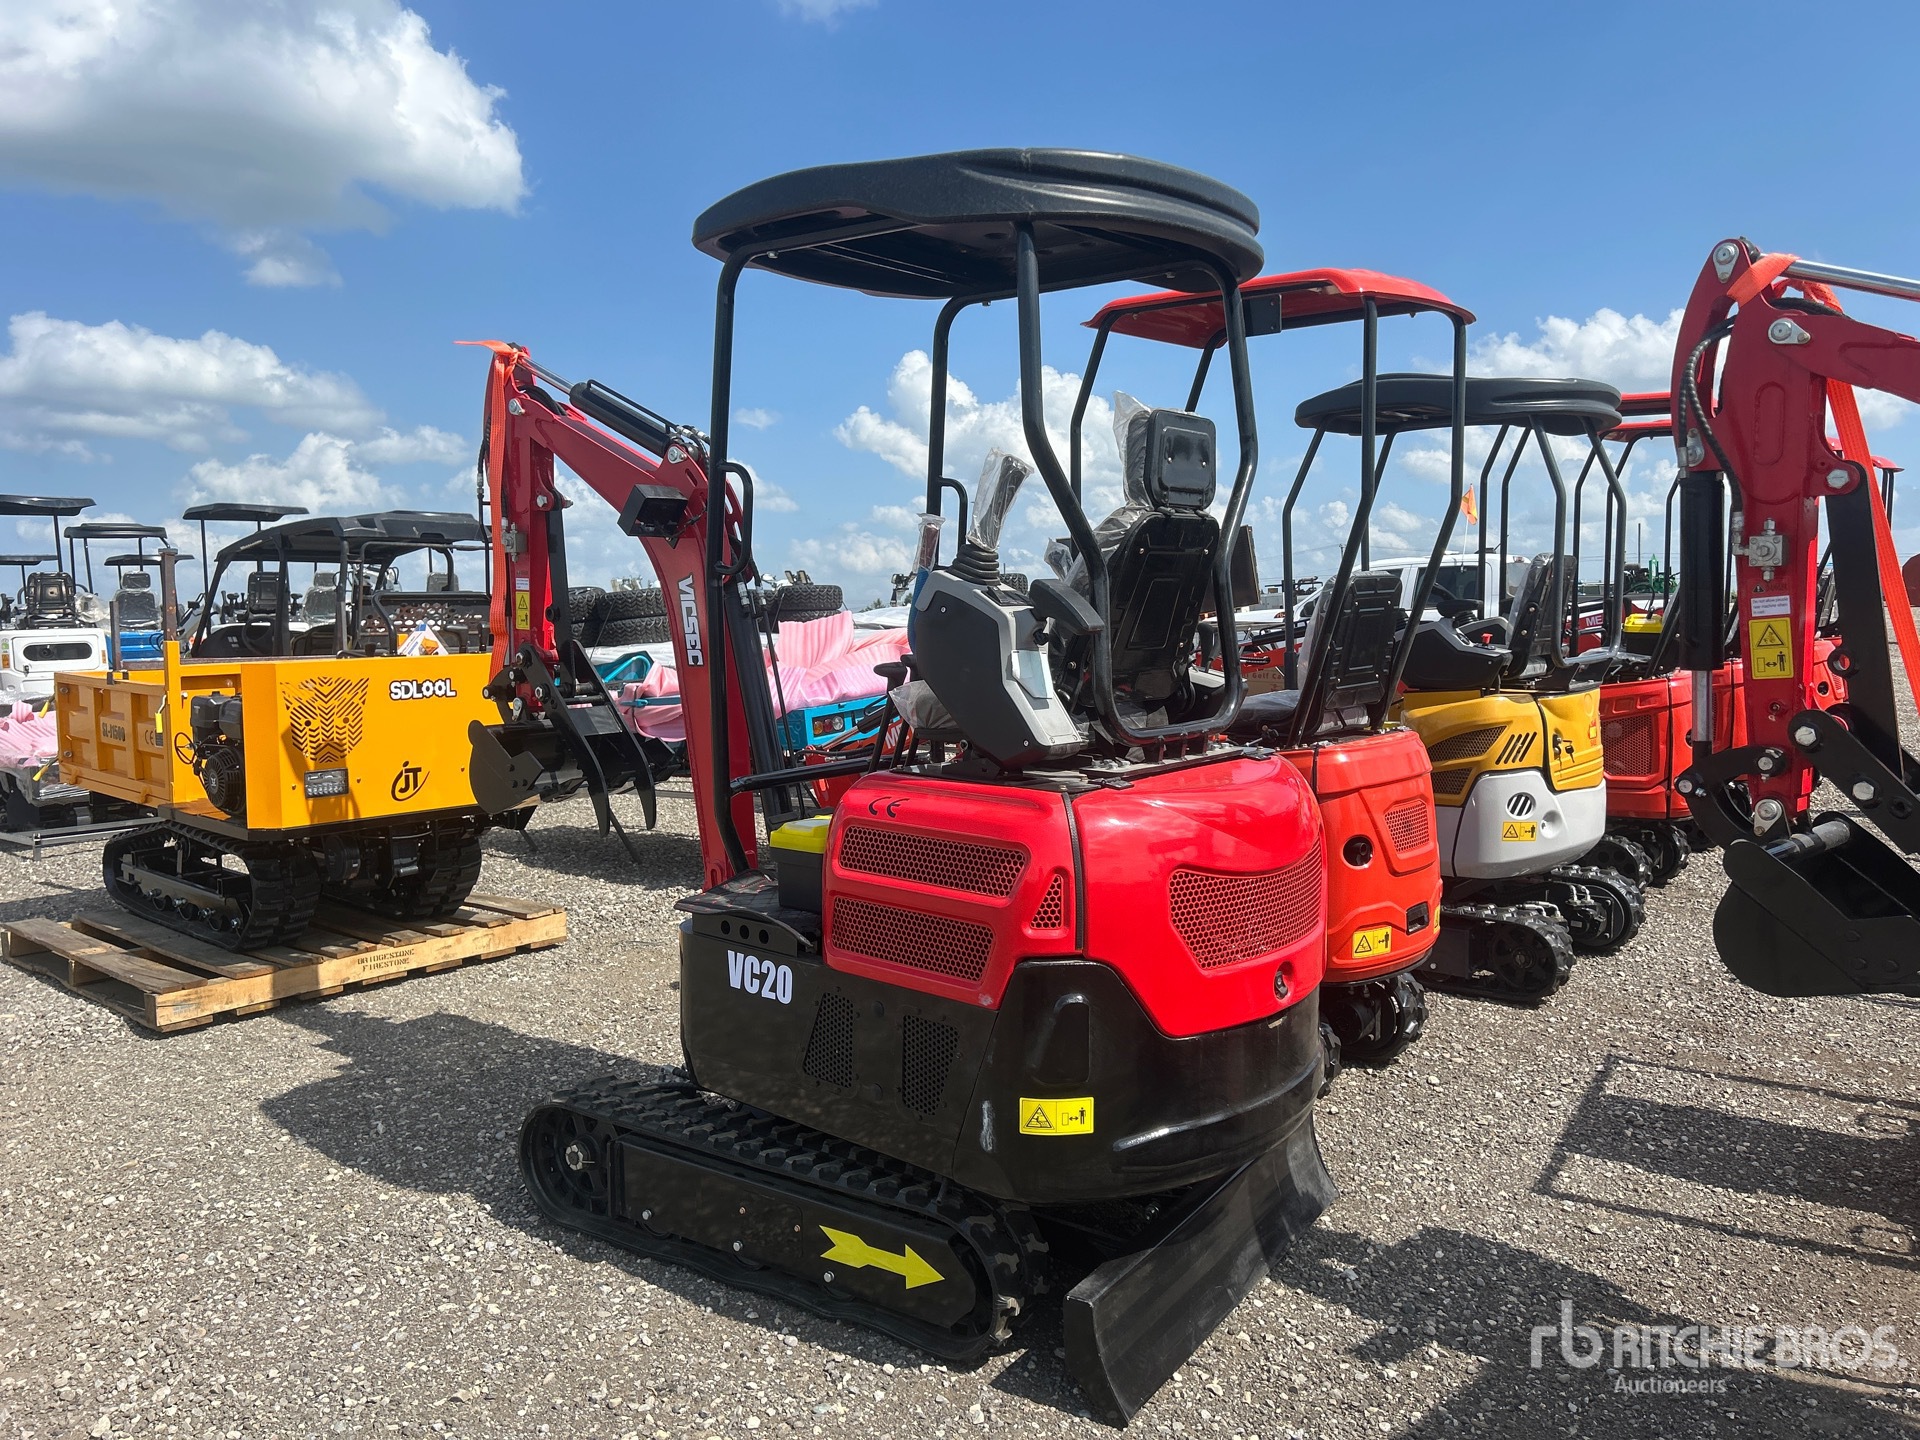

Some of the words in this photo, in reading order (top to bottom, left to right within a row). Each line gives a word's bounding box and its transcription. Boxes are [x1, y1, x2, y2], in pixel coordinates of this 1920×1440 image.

[678, 574, 704, 666] VICSEC
[1252, 672, 1269, 680] Golf
[389, 678, 457, 701] SDLOOL
[357, 948, 415, 965] BRIDGESTONE
[362, 957, 410, 972] FIRESTONE
[727, 949, 793, 1005] VC20
